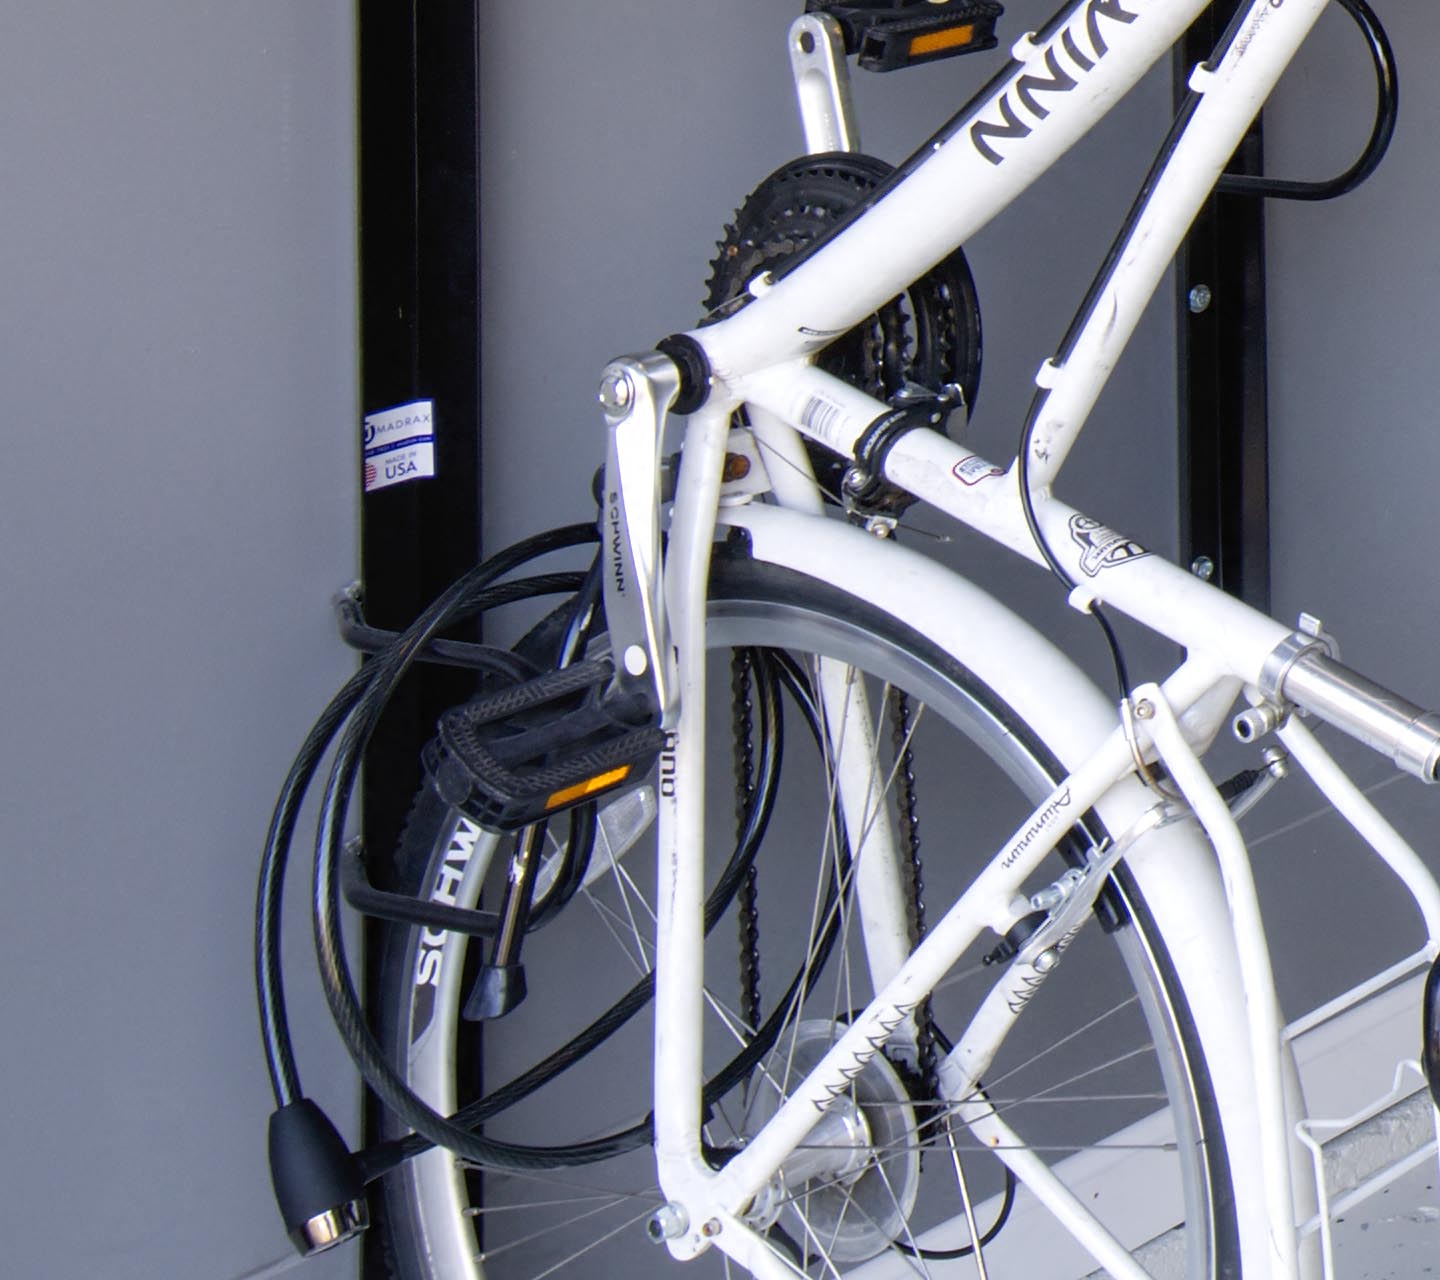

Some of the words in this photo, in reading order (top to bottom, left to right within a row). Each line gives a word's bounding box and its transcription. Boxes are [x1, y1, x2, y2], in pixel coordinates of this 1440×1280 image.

[377, 414, 431, 433] MADRAX
[385, 460, 418, 480] USA
[609, 491, 626, 598] SCHWINN
[1001, 785, 1072, 872] Aluminum
[414, 817, 485, 988] SCHW
